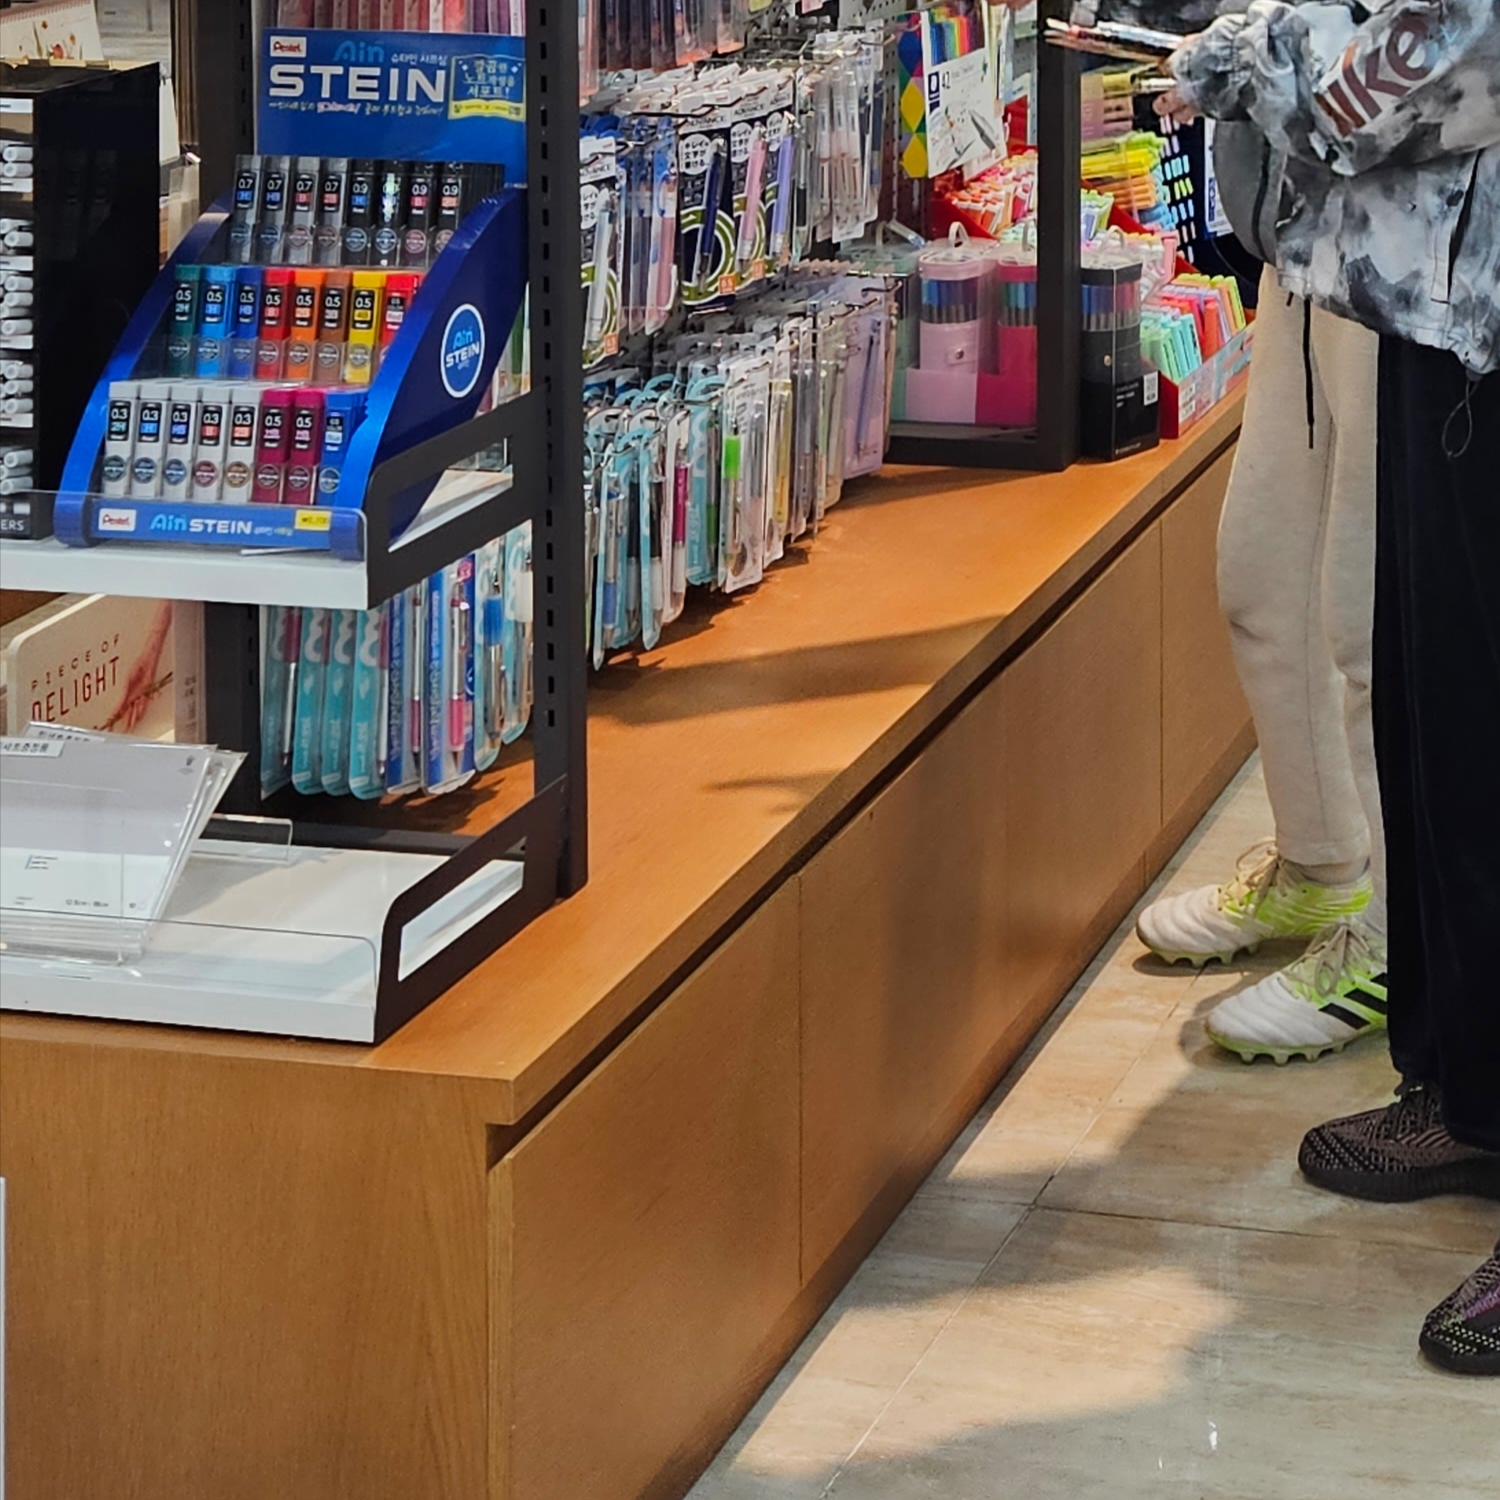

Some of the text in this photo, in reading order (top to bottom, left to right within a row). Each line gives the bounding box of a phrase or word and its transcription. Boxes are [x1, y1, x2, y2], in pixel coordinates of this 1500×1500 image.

[273, 40, 302, 53] Pentel
[332, 40, 385, 63] Ain
[269, 64, 446, 102] STEIN
[238, 179, 253, 189] 0.7
[267, 180, 282, 190] 0.7
[296, 180, 312, 191] 0.7
[325, 181, 338, 192] 0.7
[353, 183, 368, 194] 0.9
[412, 184, 427, 196] 0.9
[442, 186, 457, 196] 0.9
[176, 289, 192, 301] 0.5
[206, 291, 223, 302] 0.5
[240, 292, 254, 303] 0.5
[265, 294, 281, 305] 0.5
[296, 295, 312, 306] 0.5
[325, 296, 341, 308] 0.5
[355, 297, 372, 308] 0.5
[446, 341, 479, 368] STEIN
[111, 407, 128, 419] 0.3
[142, 410, 158, 421] 0.3
[172, 411, 189, 423] 0.3
[203, 413, 219, 424] 0.3
[234, 413, 251, 425] 0.3
[265, 415, 282, 427] 0.5
[296, 416, 312, 428] 0.5
[102, 514, 252, 534] Pentel Ain STEIN
[31, 634, 119, 690] PIECE OF
